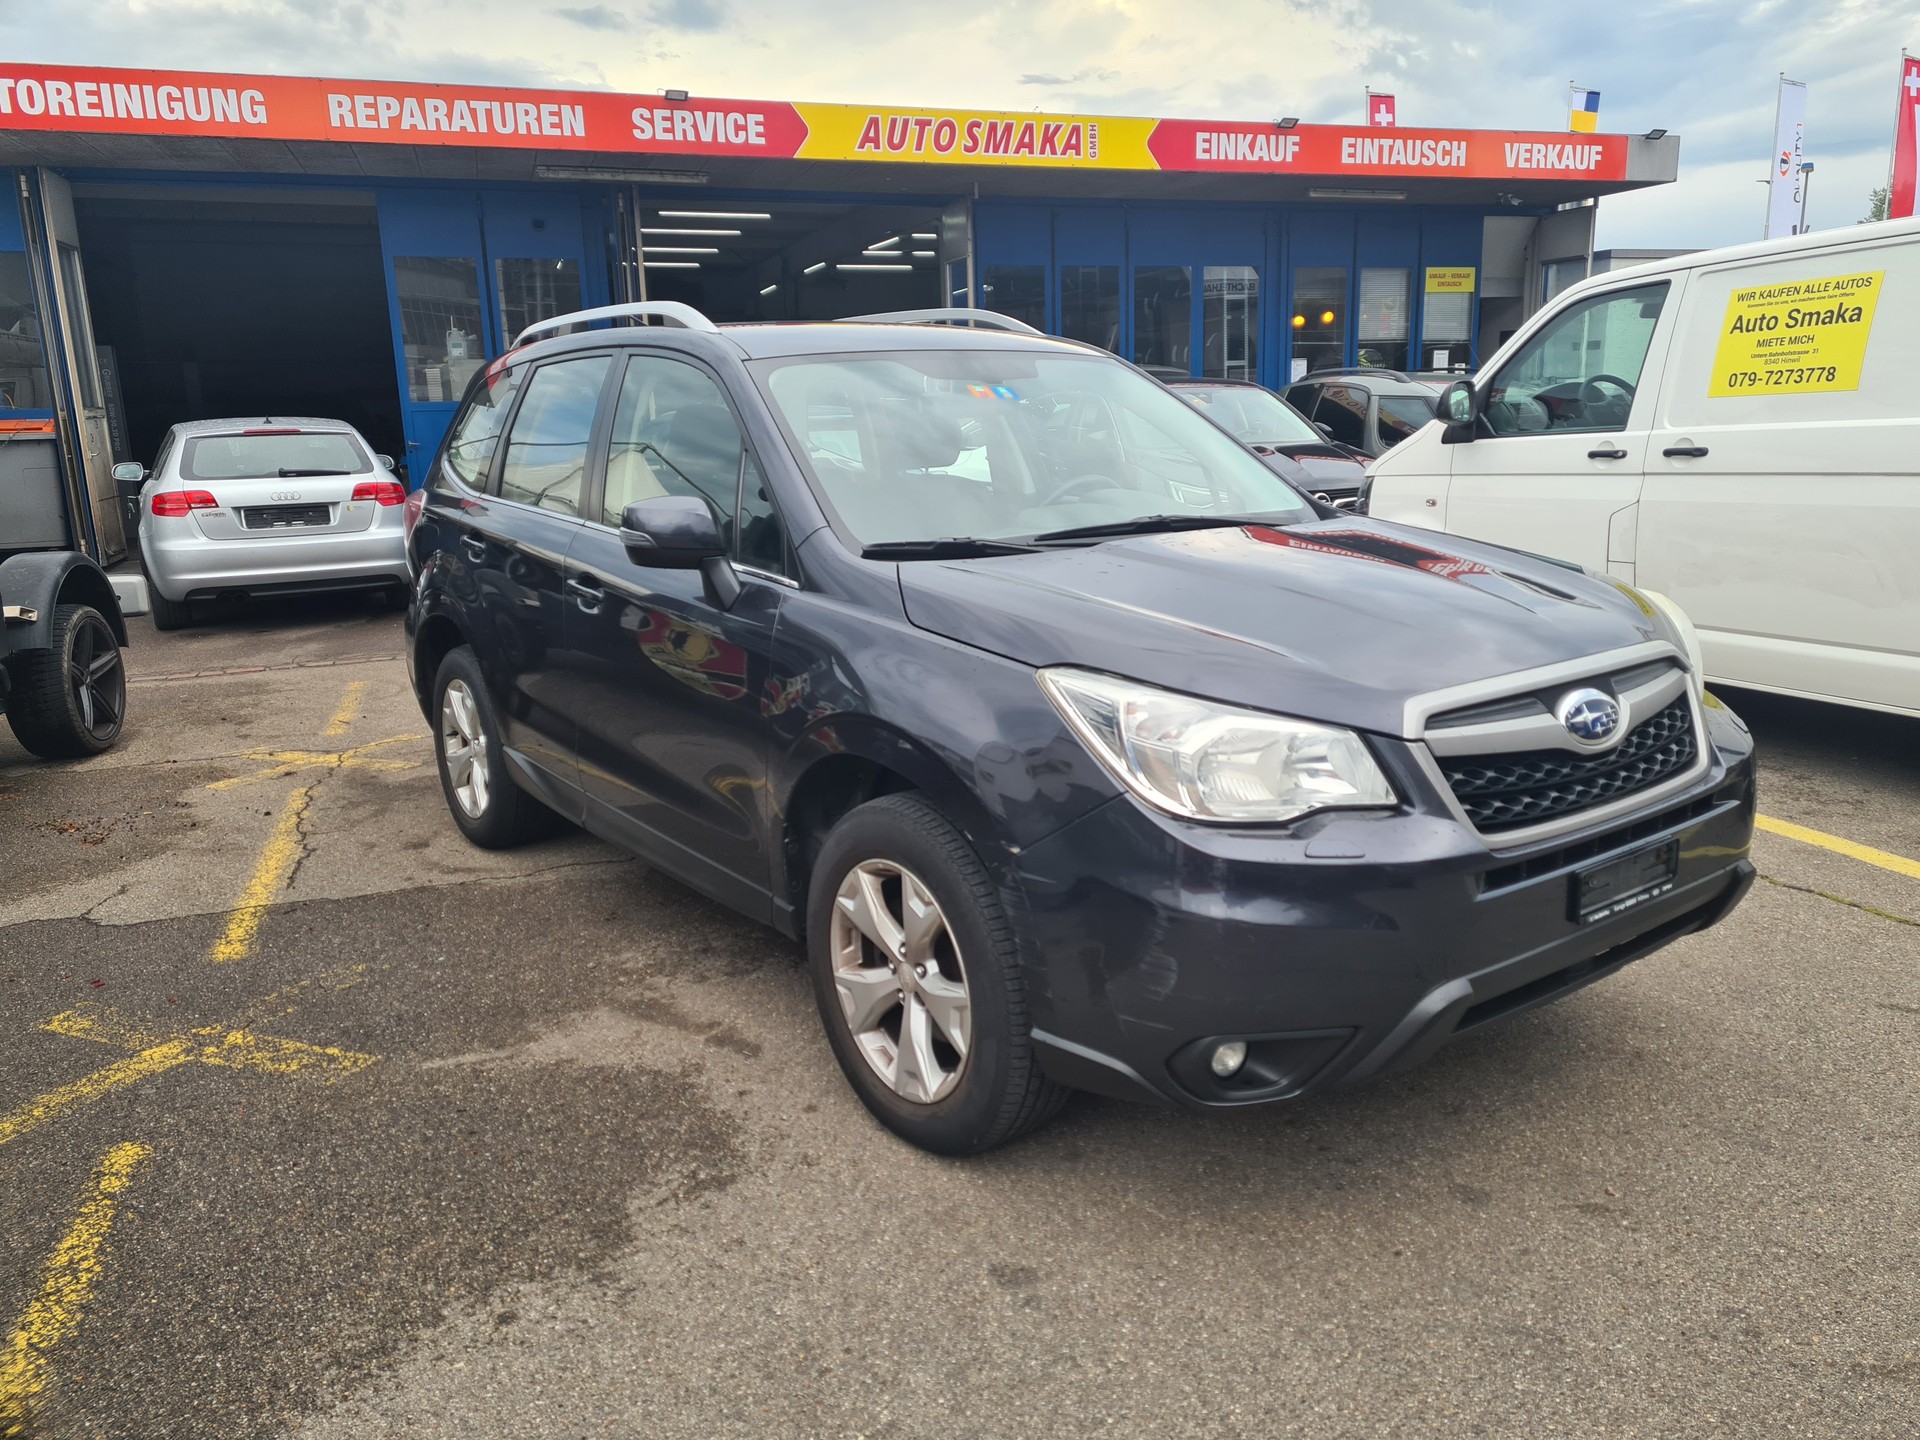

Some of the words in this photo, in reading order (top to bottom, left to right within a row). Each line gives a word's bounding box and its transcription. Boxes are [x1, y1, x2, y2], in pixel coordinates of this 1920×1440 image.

[327, 93, 586, 137] REPARATUREN
[631, 107, 766, 145] SERVICE
[854, 114, 960, 154] AUTO
[962, 118, 1083, 159] SMAKA
[1087, 123, 1098, 160] GMBH
[1195, 131, 1300, 162] EINKAUF
[1341, 137, 1467, 167] EINTAUSCH
[1504, 142, 1603, 170] VERKAUF
[1737, 291, 1757, 303] WIR
[1758, 286, 1800, 300] KAUFEN
[1803, 281, 1831, 294] ALLE
[1833, 276, 1873, 291] AUTOS
[1730, 314, 1779, 335] Auto
[1785, 302, 1863, 329] Smaka
[1756, 337, 1786, 348] MIETE
[1788, 334, 1815, 345] MICH
[1764, 358, 1780, 366] 8340
[1781, 356, 1801, 364] Hinwil
[1728, 366, 1837, 388] 079-7273778
